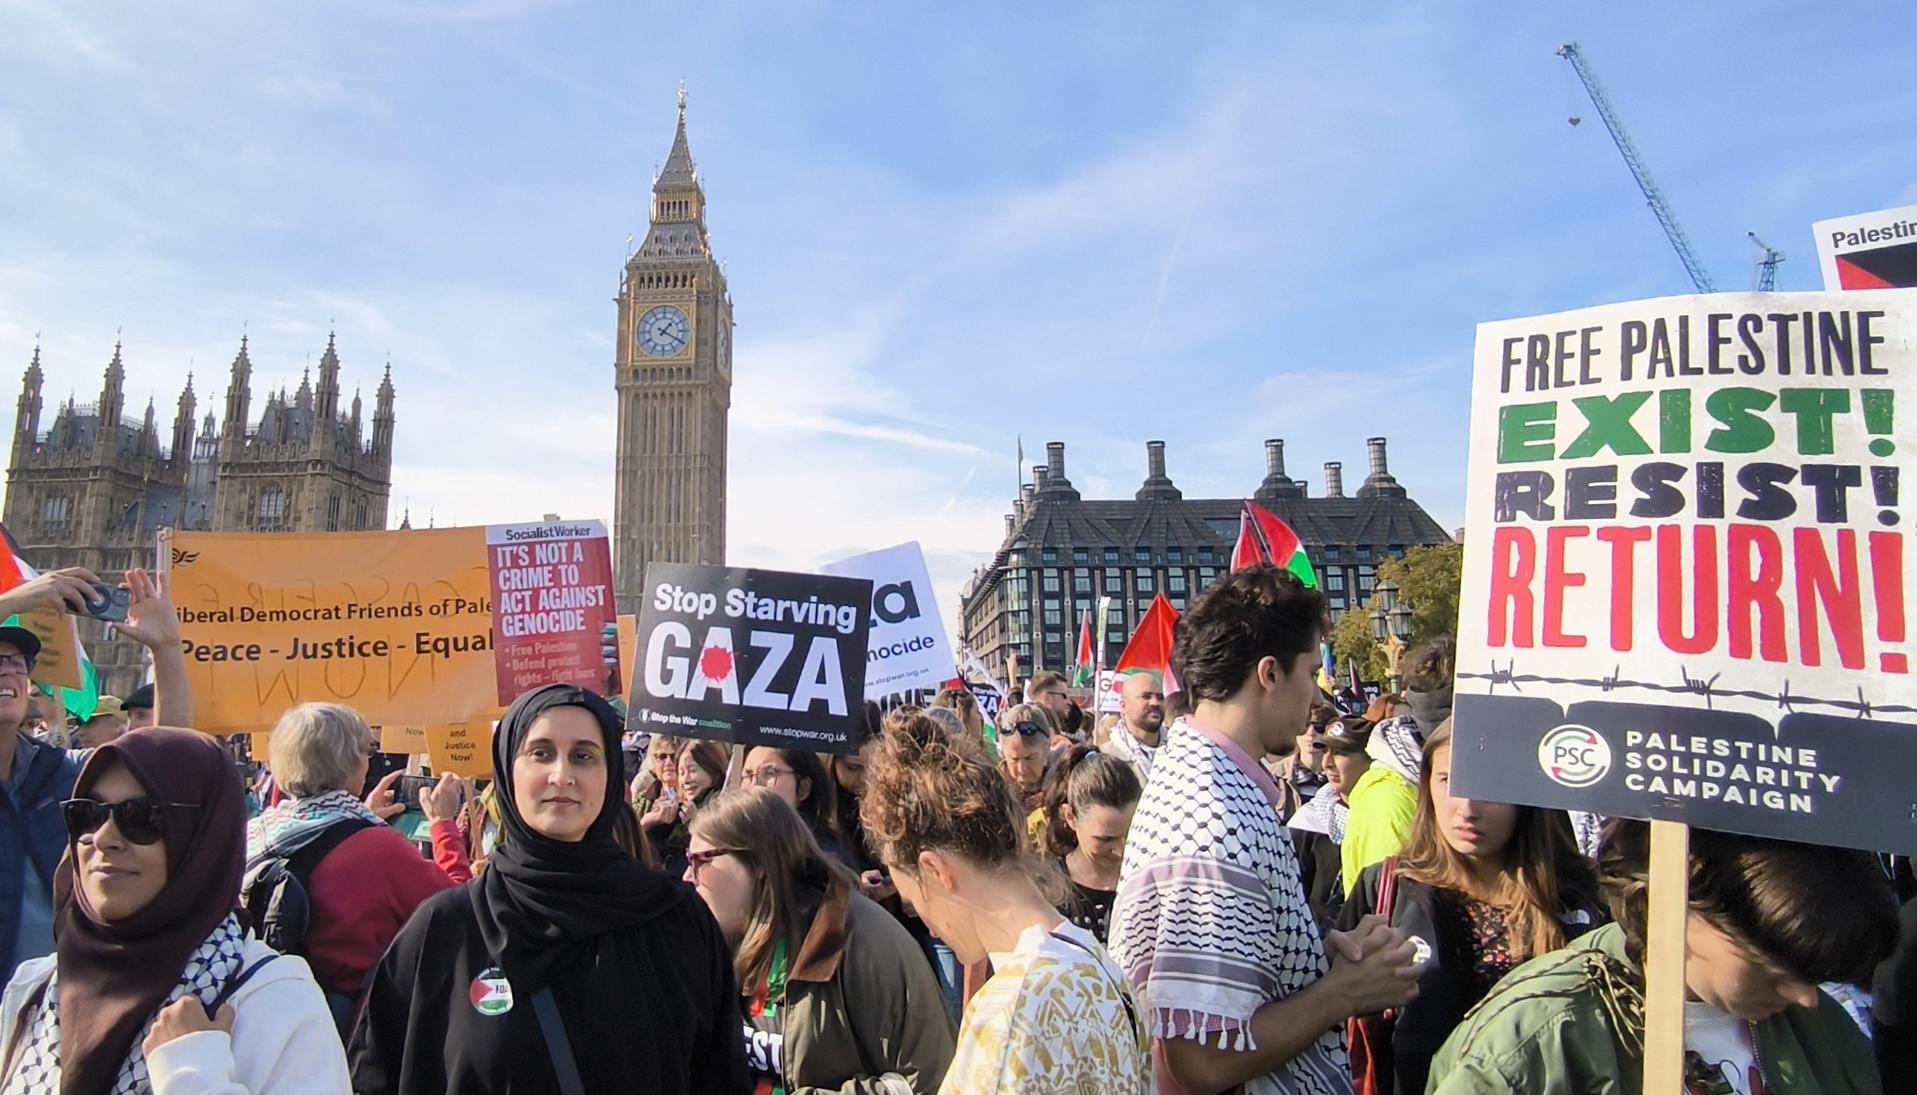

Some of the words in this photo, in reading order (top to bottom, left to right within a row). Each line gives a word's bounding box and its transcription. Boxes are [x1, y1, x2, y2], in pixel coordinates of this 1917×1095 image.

[1501, 326, 1602, 393] FREE
[1620, 311, 1889, 381] PALESTINE
[1497, 387, 1895, 463] EXIST!
[1494, 461, 1900, 526] RESIST!
[505, 527, 553, 541] Socialist
[555, 526, 591, 538] Worker
[497, 545, 529, 567] IT'S
[535, 543, 568, 565] NOT
[573, 542, 584, 562] A
[498, 566, 554, 590] CRIME
[558, 565, 579, 585] TO
[177, 606, 234, 623] iberal
[240, 603, 341, 623] Democrat
[347, 600, 423, 620] Friends
[429, 599, 450, 616] of
[501, 590, 532, 614] ACT
[539, 585, 606, 611] AGAINST
[654, 583, 717, 620] Stop
[725, 587, 857, 634] Starving
[869, 580, 921, 628] a
[1487, 524, 1908, 673] RETURN!
[502, 610, 586, 637] GENOCIDE
[286, 635, 388, 660] Justice
[644, 621, 848, 717] GAZA
[450, 729, 466, 737] and
[651, 712, 668, 724] Stop
[669, 714, 681, 724] the
[682, 716, 698, 726] War
[444, 741, 476, 750] Justice
[760, 726, 847, 743] www.stopwar.org.uk
[1554, 746, 1595, 767] PSC
[1626, 730, 1817, 768] PALESTINE
[1625, 752, 1840, 793] SOLIDARITY
[1625, 774, 1812, 813] CAMPAIGN
